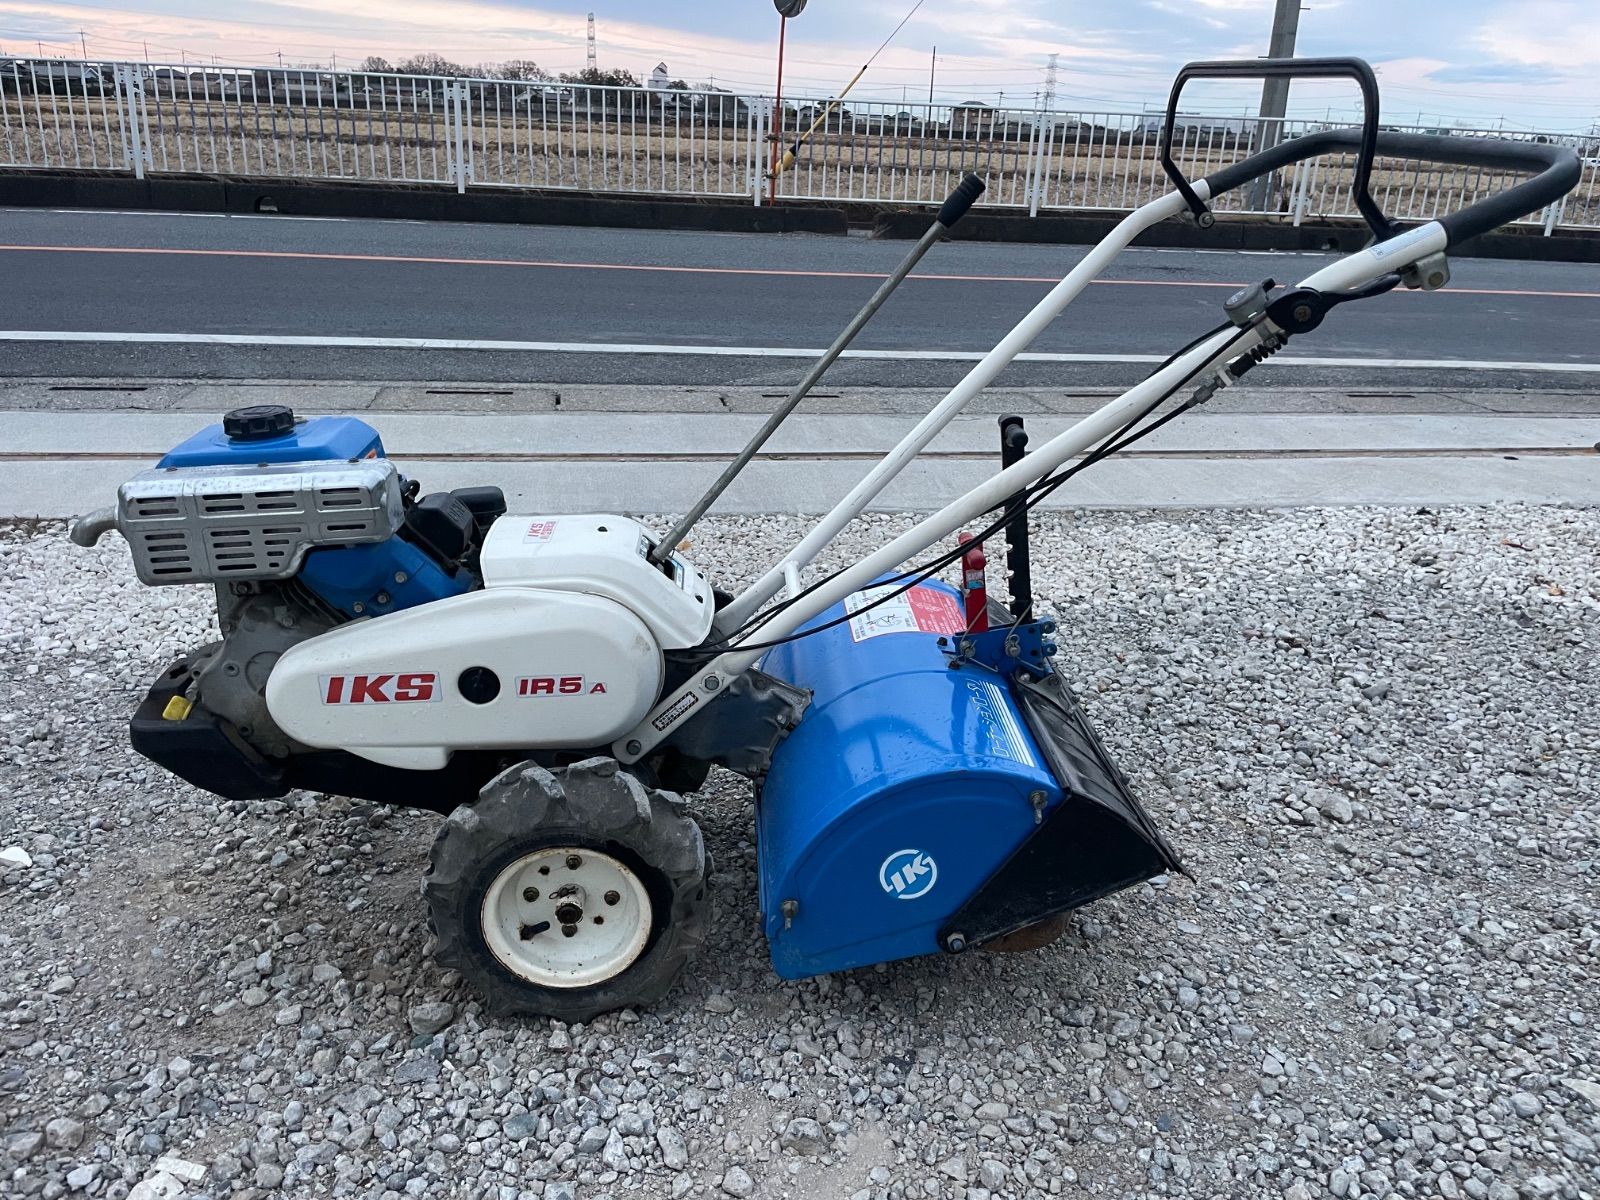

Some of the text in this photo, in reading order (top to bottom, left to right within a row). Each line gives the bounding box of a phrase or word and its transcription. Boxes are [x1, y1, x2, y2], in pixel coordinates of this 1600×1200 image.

[527, 523, 544, 537] IKS
[326, 673, 436, 703] IKS
[519, 676, 607, 695] IR5 A
